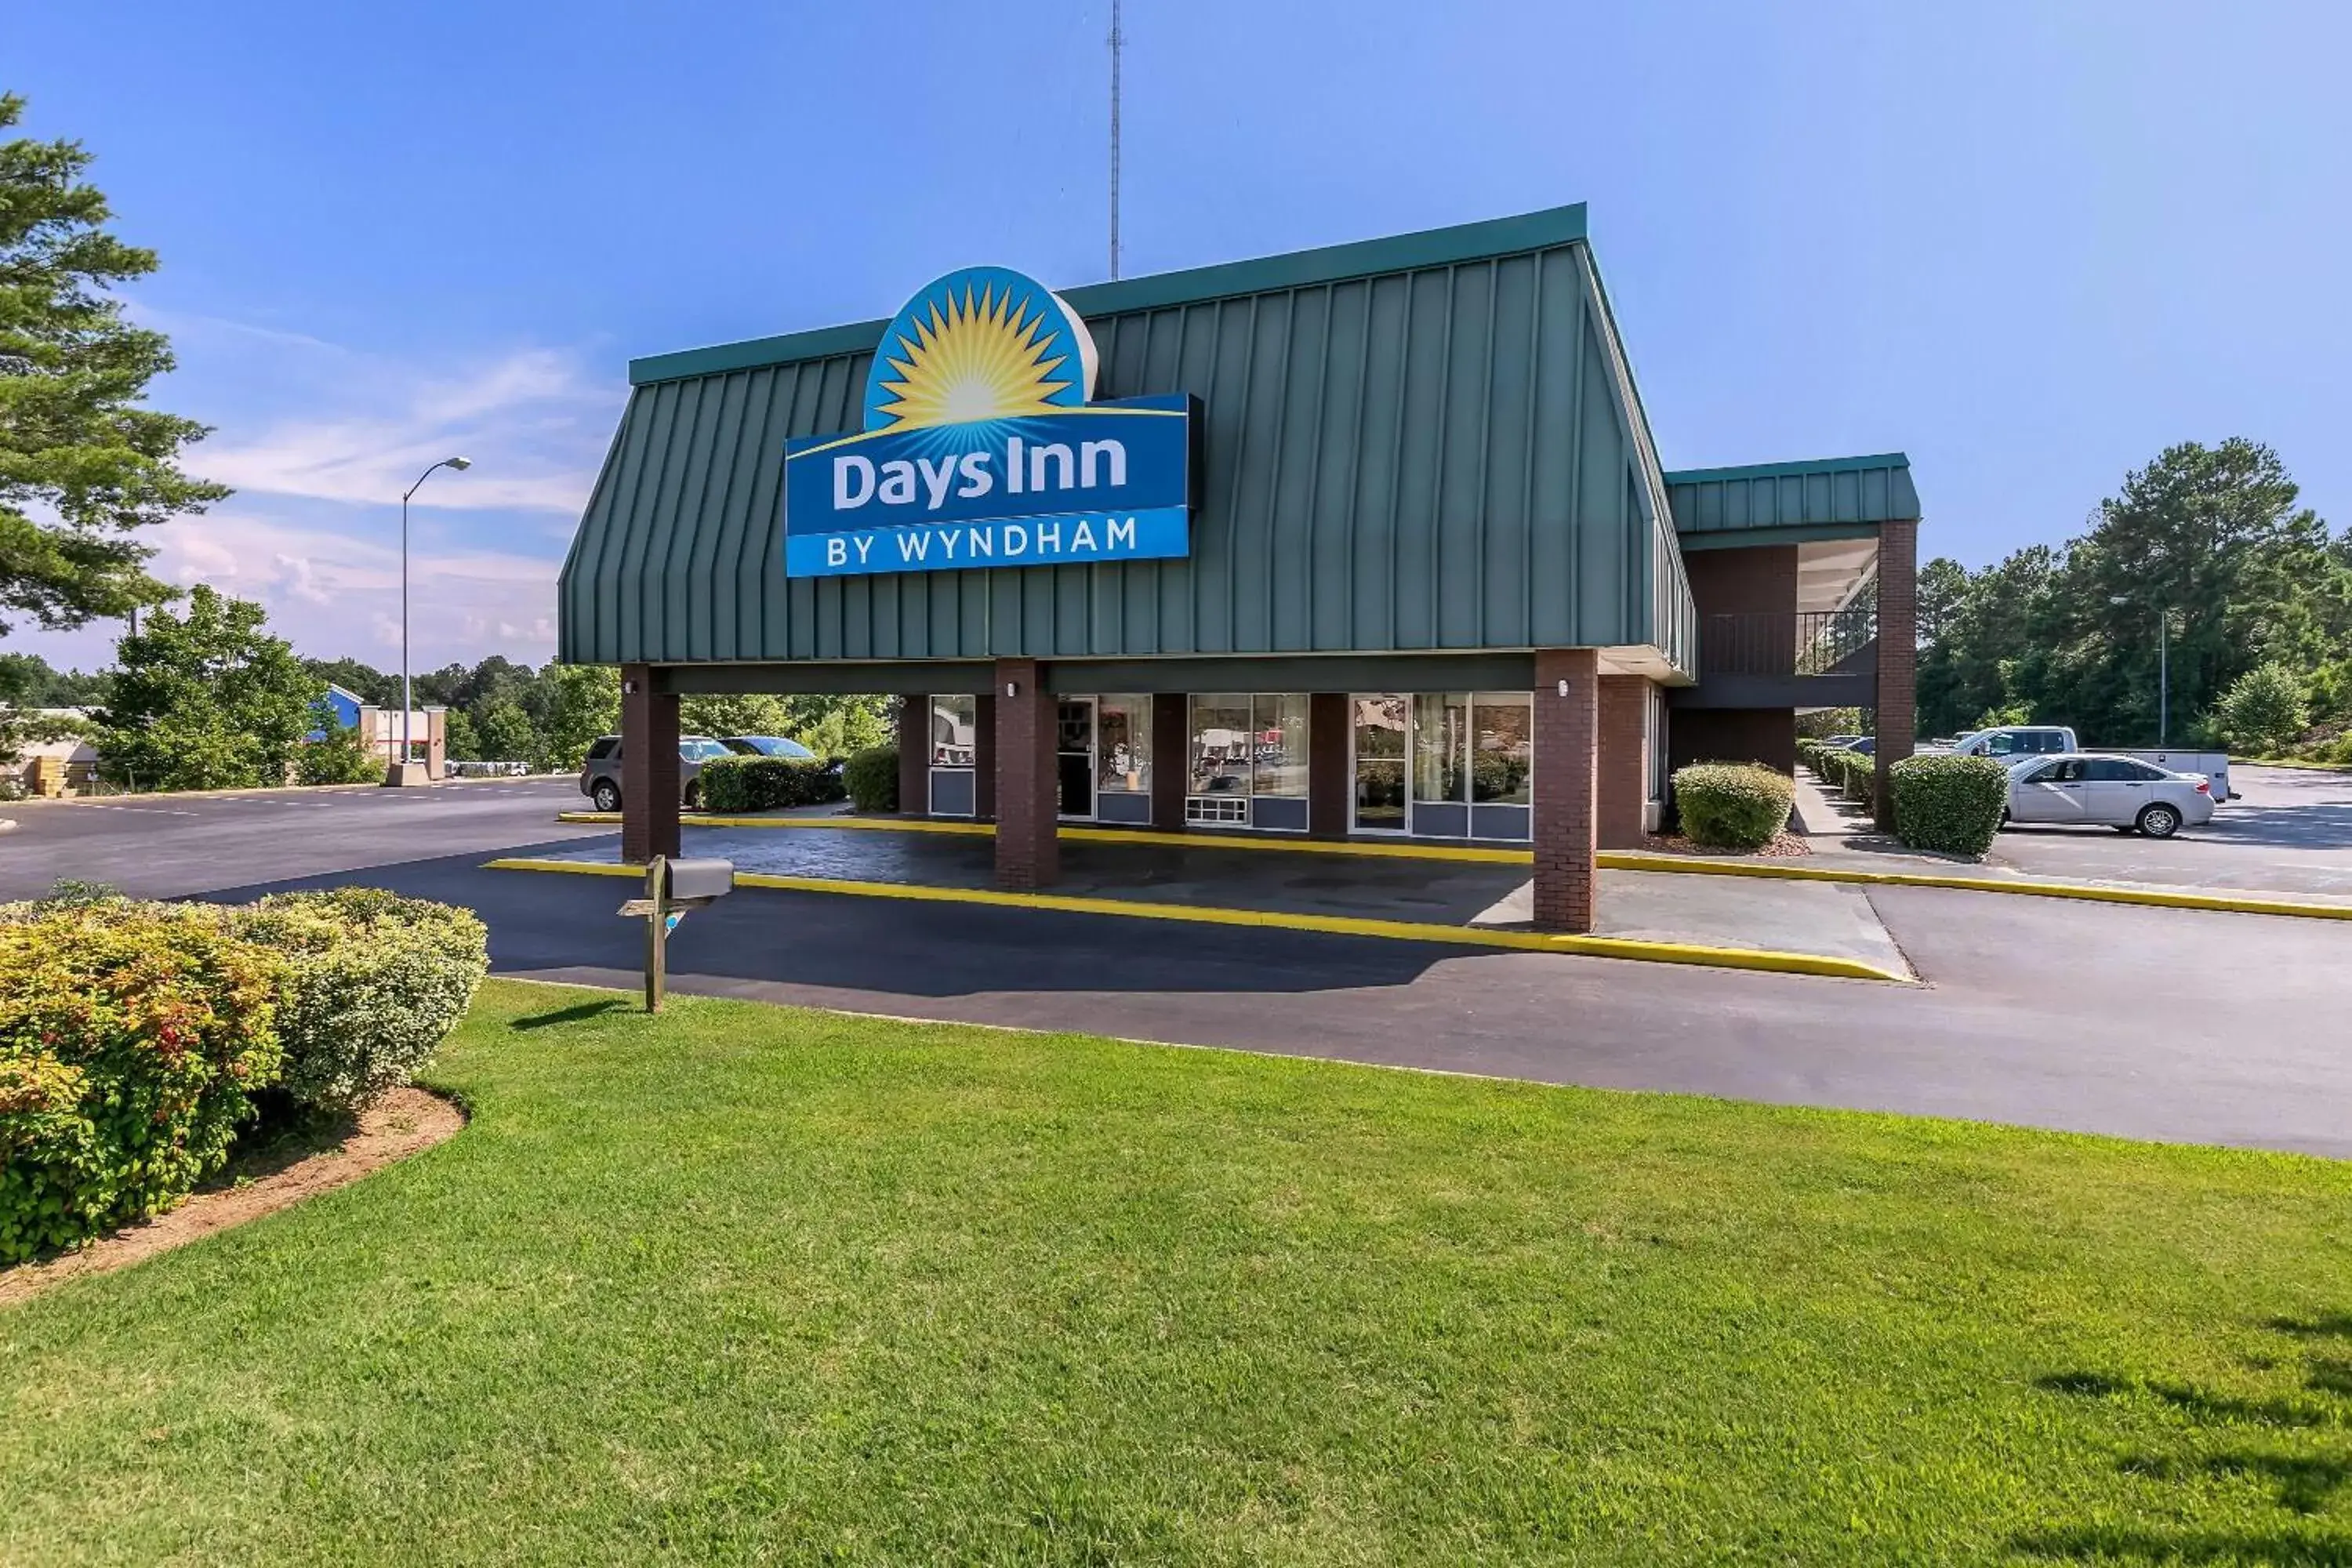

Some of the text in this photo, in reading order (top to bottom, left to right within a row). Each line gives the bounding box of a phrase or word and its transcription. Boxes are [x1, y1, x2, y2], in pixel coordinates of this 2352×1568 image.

[833, 437, 1127, 510] Days Inn
[827, 517, 1136, 566] BY WYNDHAM
